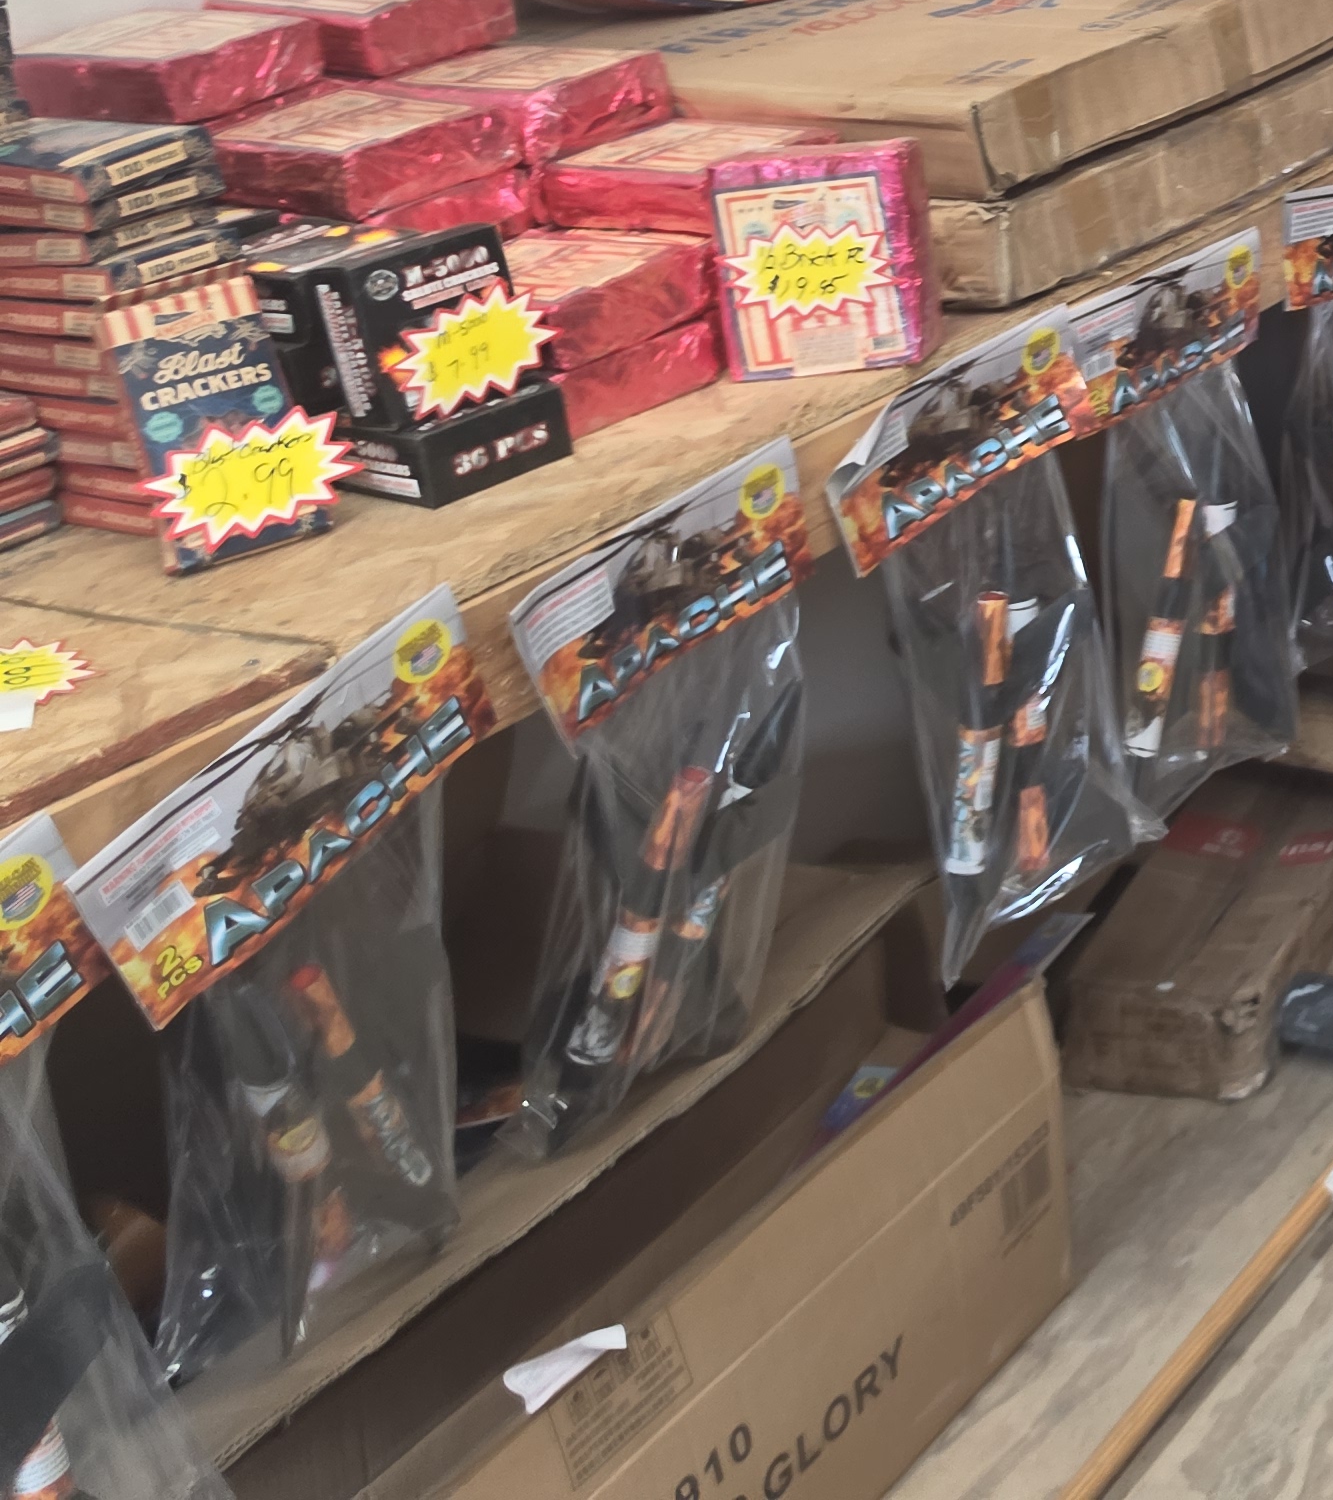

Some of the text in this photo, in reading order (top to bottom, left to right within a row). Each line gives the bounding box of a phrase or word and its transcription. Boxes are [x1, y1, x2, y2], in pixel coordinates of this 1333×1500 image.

[139, 362, 273, 412] CRACKERS
[152, 341, 246, 384] Blast
[1111, 309, 1246, 415] APACHE
[881, 393, 1071, 539] APACHE
[577, 539, 793, 721] APACHE
[203, 695, 474, 968] APACHE
[155, 945, 182, 978] 2
[156, 955, 204, 1000] PCS
[762, 1332, 904, 1500] GLORY
